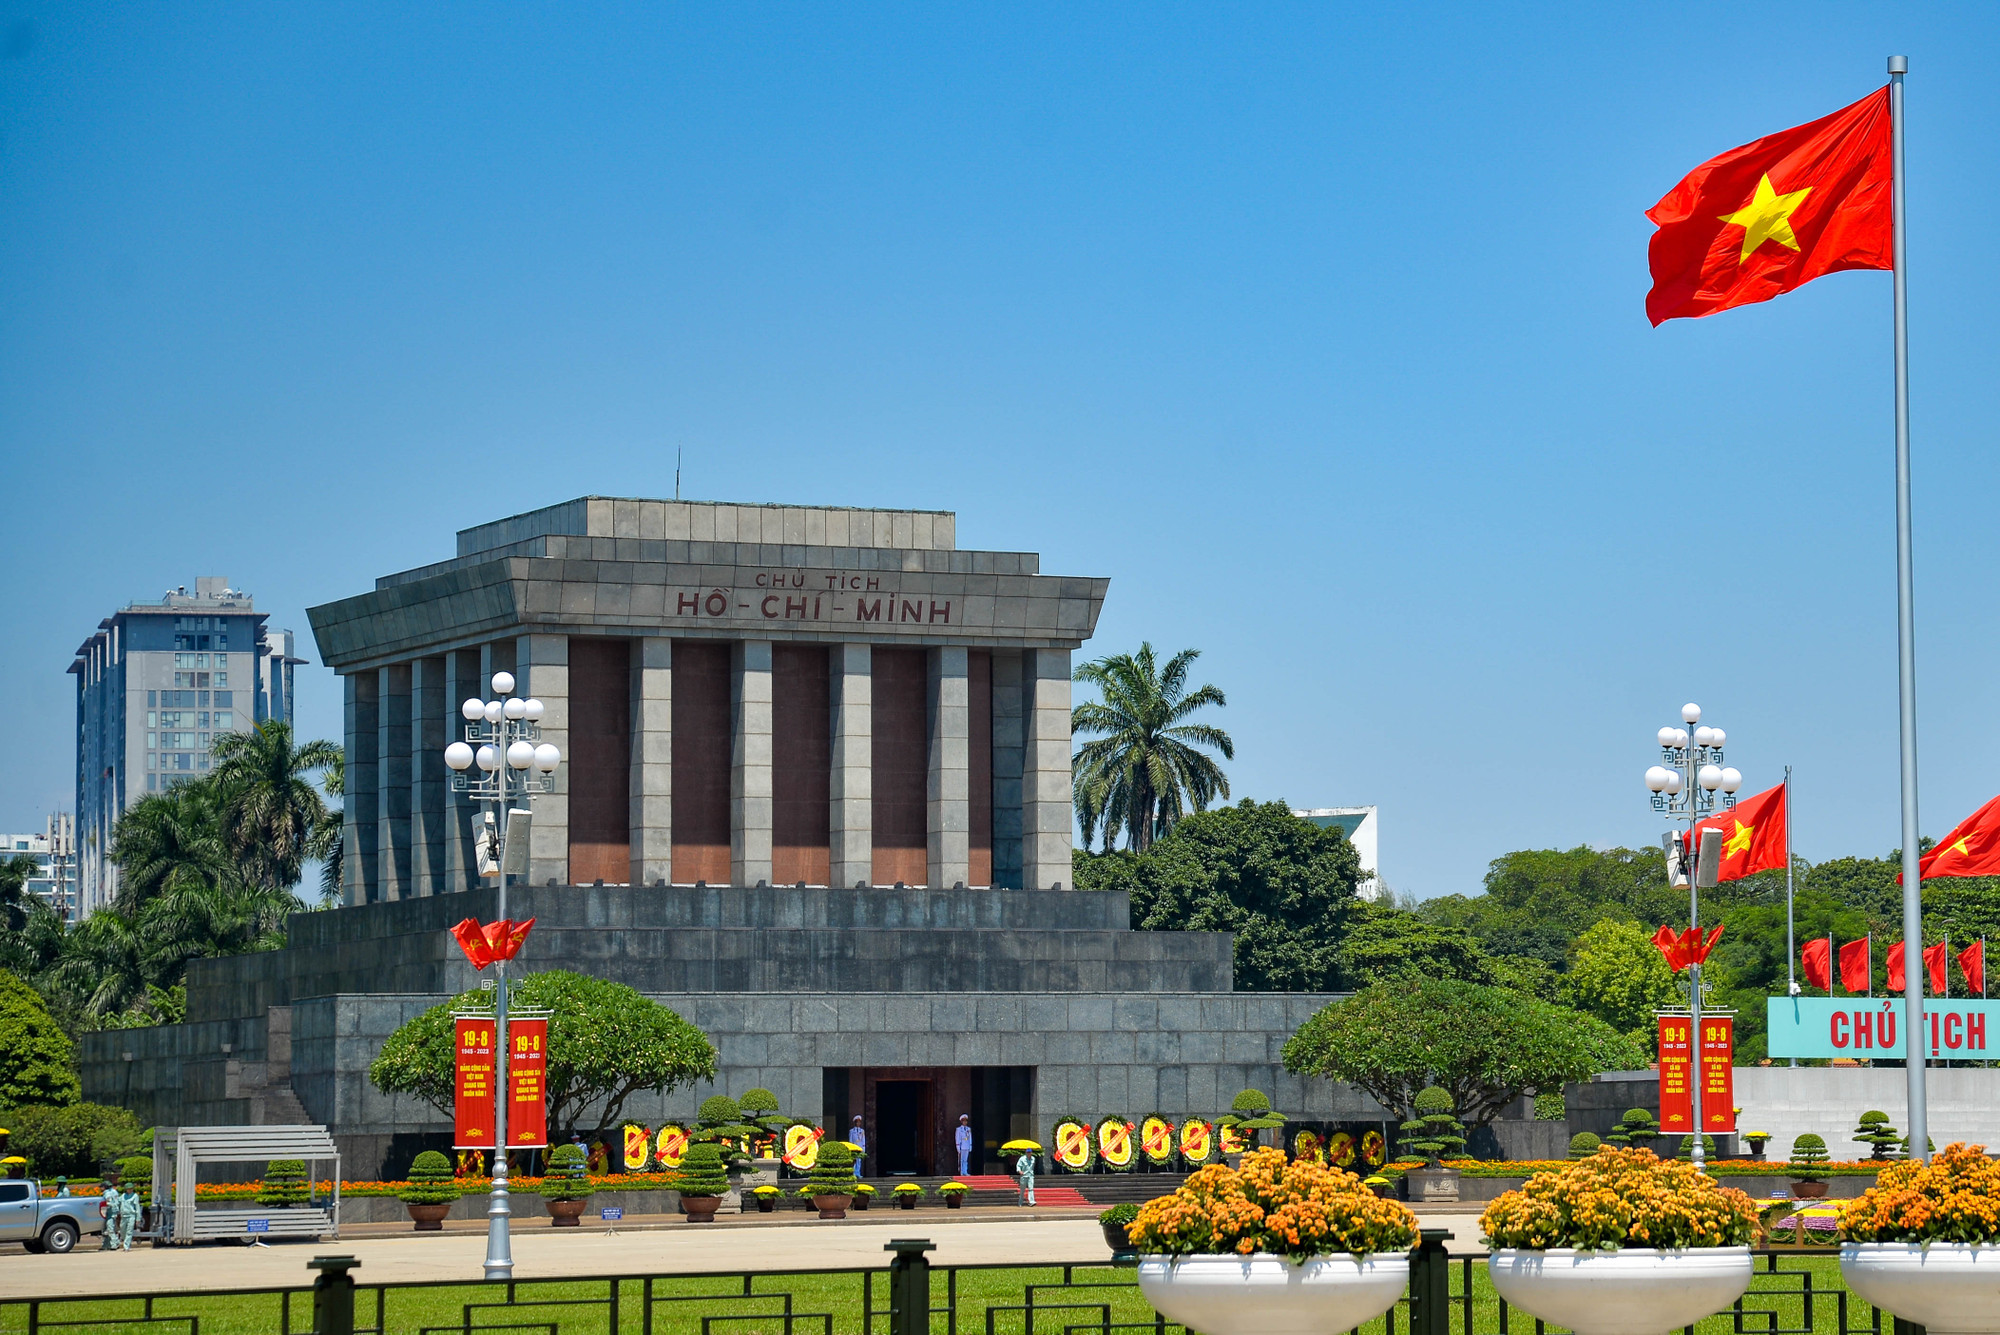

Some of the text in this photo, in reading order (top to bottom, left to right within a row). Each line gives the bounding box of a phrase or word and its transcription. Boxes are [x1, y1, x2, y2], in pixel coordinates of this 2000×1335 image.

[756, 568, 805, 588] CHỦ
[1664, 1027, 1685, 1042] 19-8
[1706, 1027, 1727, 1042] 19-8
[1830, 1000, 1986, 1057] CHỦ ỊCH
[463, 1030, 488, 1046] 19-8
[516, 1035, 540, 1052] 19-8
